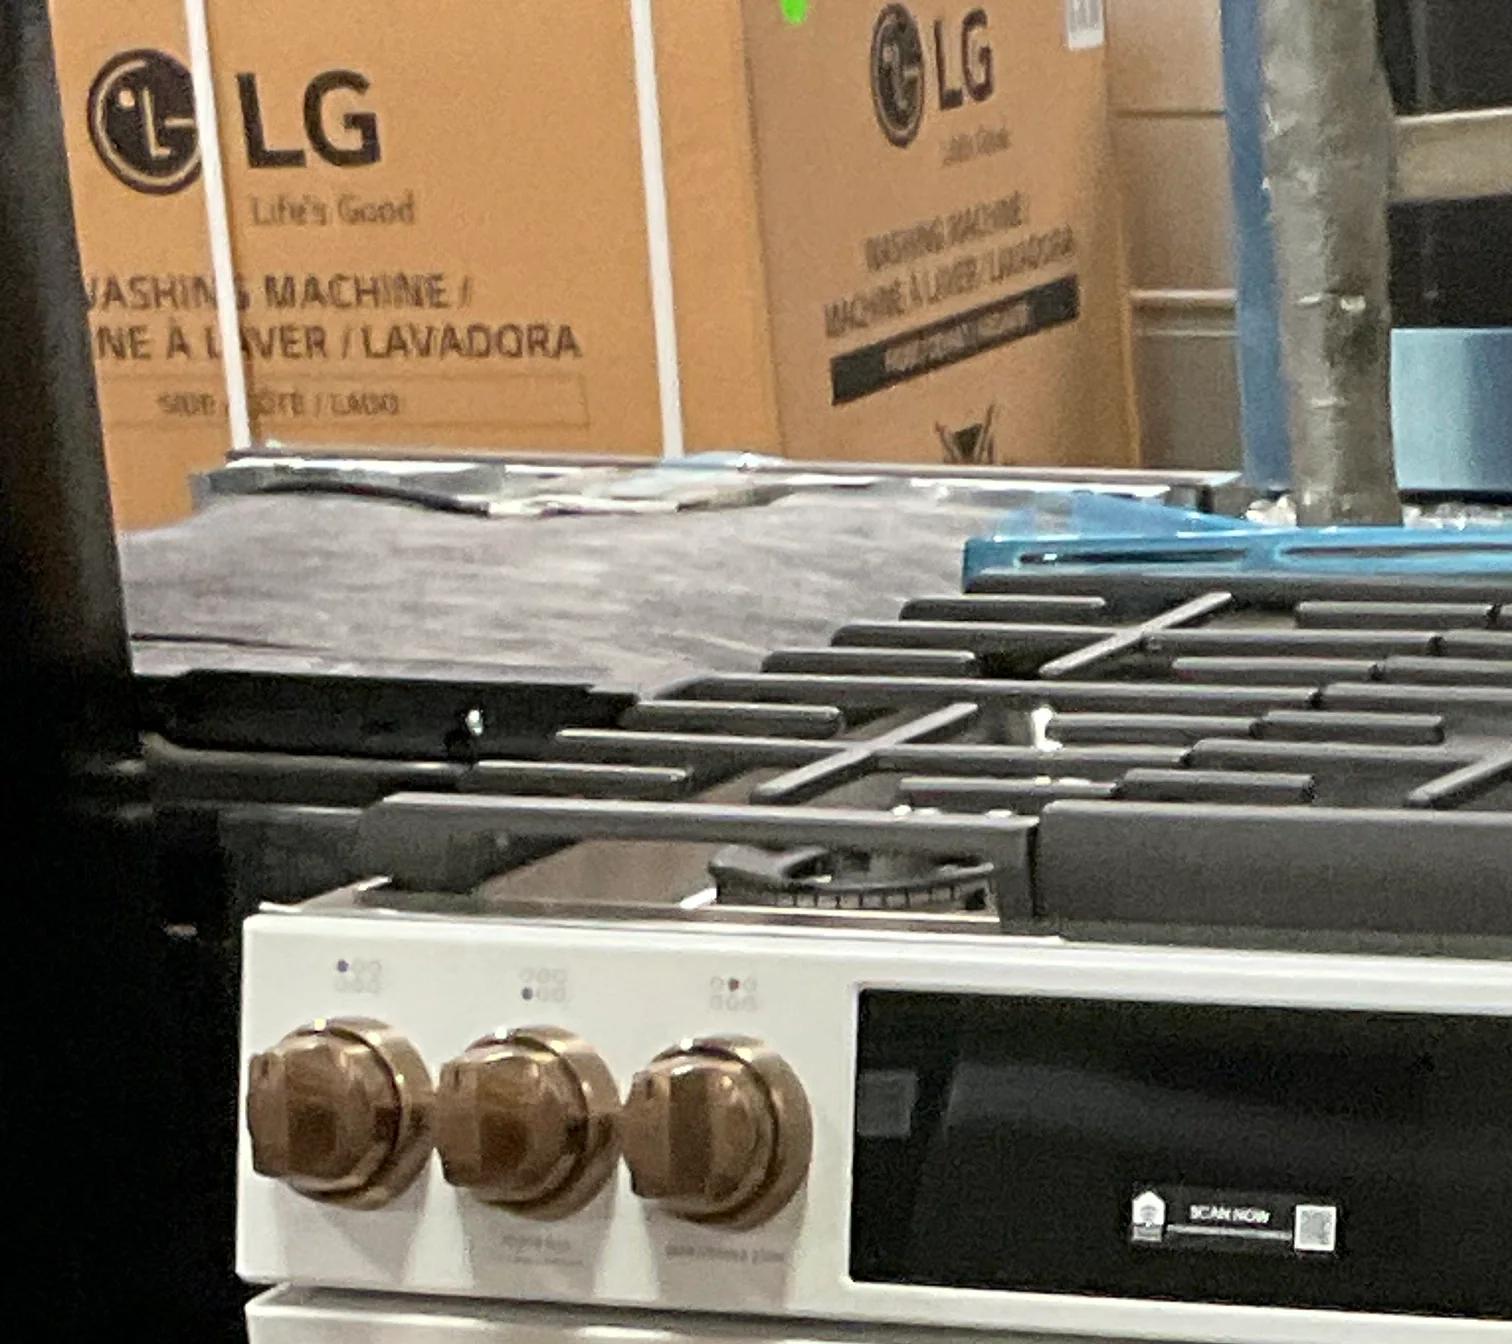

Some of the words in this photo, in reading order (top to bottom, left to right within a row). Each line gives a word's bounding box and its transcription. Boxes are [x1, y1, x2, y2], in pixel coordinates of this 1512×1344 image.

[934, 9, 995, 111] LG
[237, 69, 382, 170] LG
[337, 189, 416, 226] Good
[265, 273, 451, 310] MACHINE
[361, 321, 583, 360] LAVADORA
[1190, 1204, 1231, 1221] SCAN
[1232, 1207, 1271, 1224] NOW
